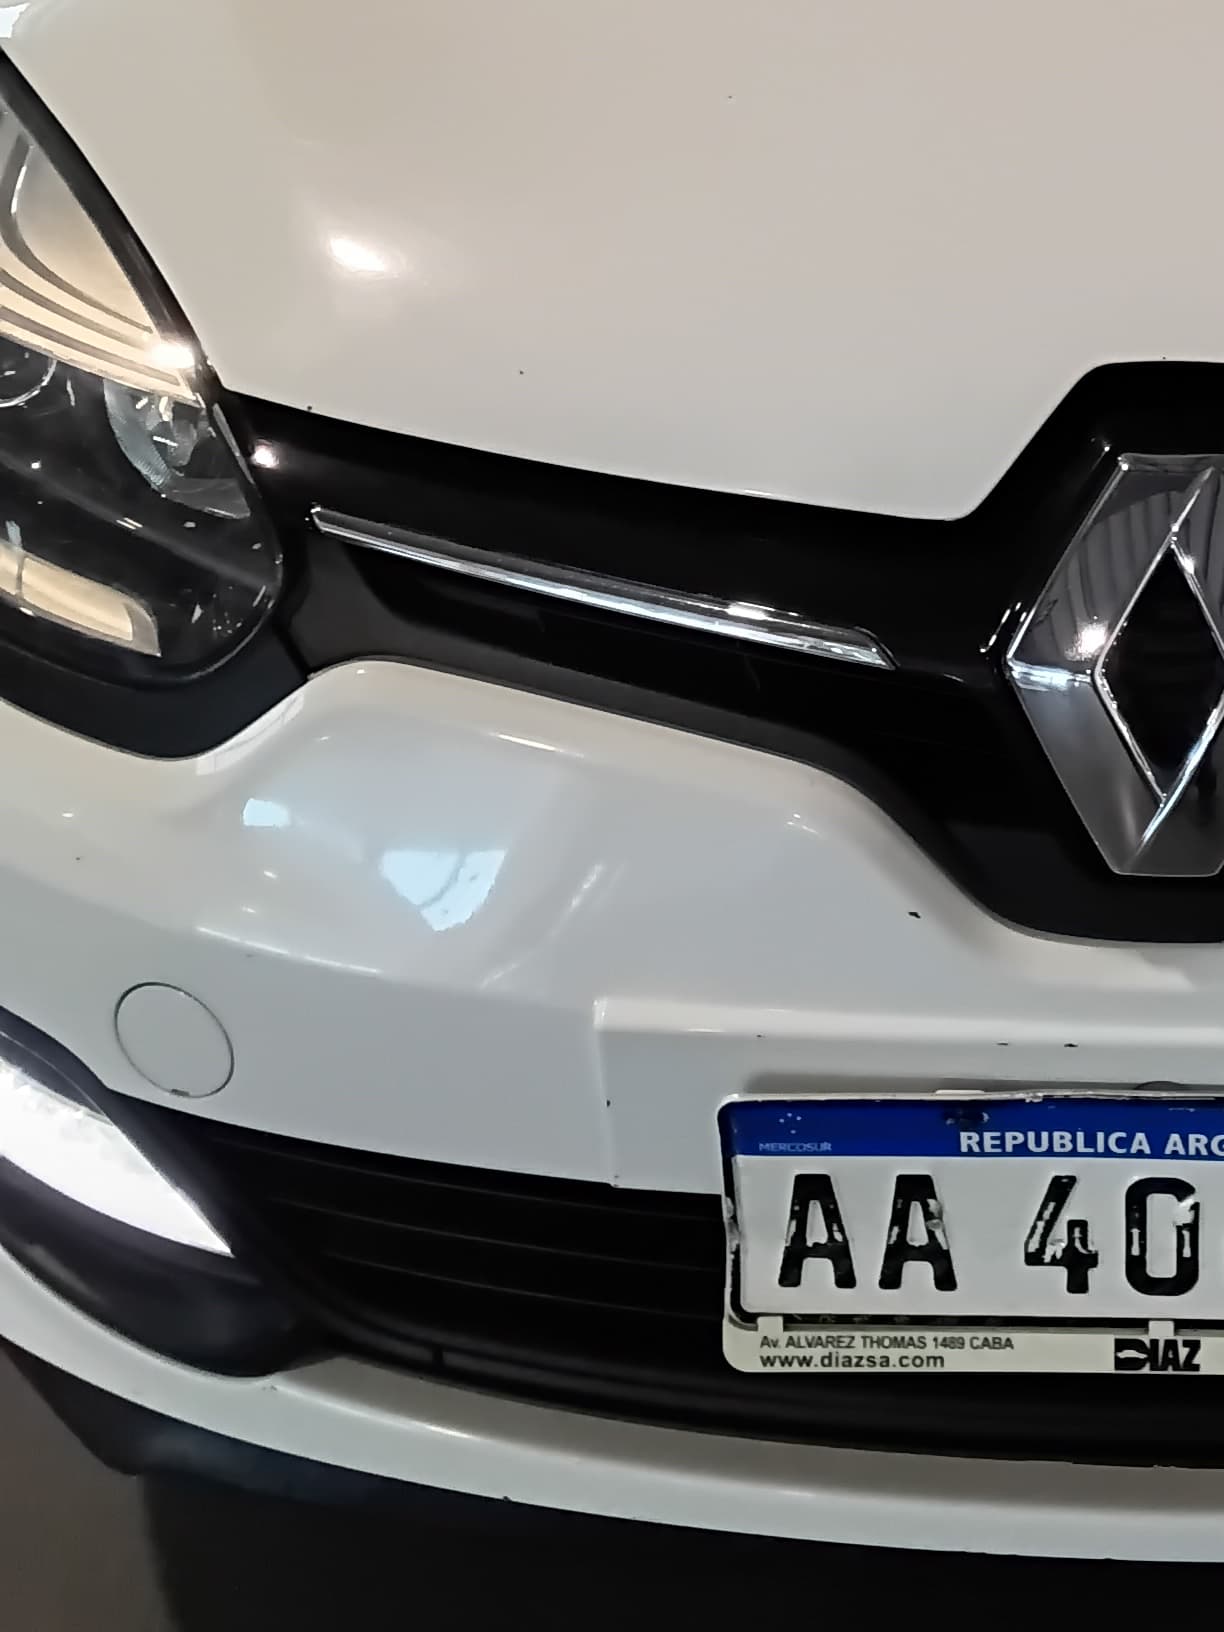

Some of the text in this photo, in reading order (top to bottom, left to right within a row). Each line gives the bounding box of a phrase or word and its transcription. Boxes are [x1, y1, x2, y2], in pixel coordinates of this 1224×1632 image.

[758, 1141, 833, 1153] MERCOSUR
[959, 1131, 1151, 1155] REPUBLICA
[777, 1173, 958, 1292] AA
[785, 1335, 856, 1349] ALVAREZ
[861, 1335, 928, 1350] THOMAS
[969, 1336, 1015, 1351] CABA
[759, 1351, 946, 1368] www.diazsa.com
